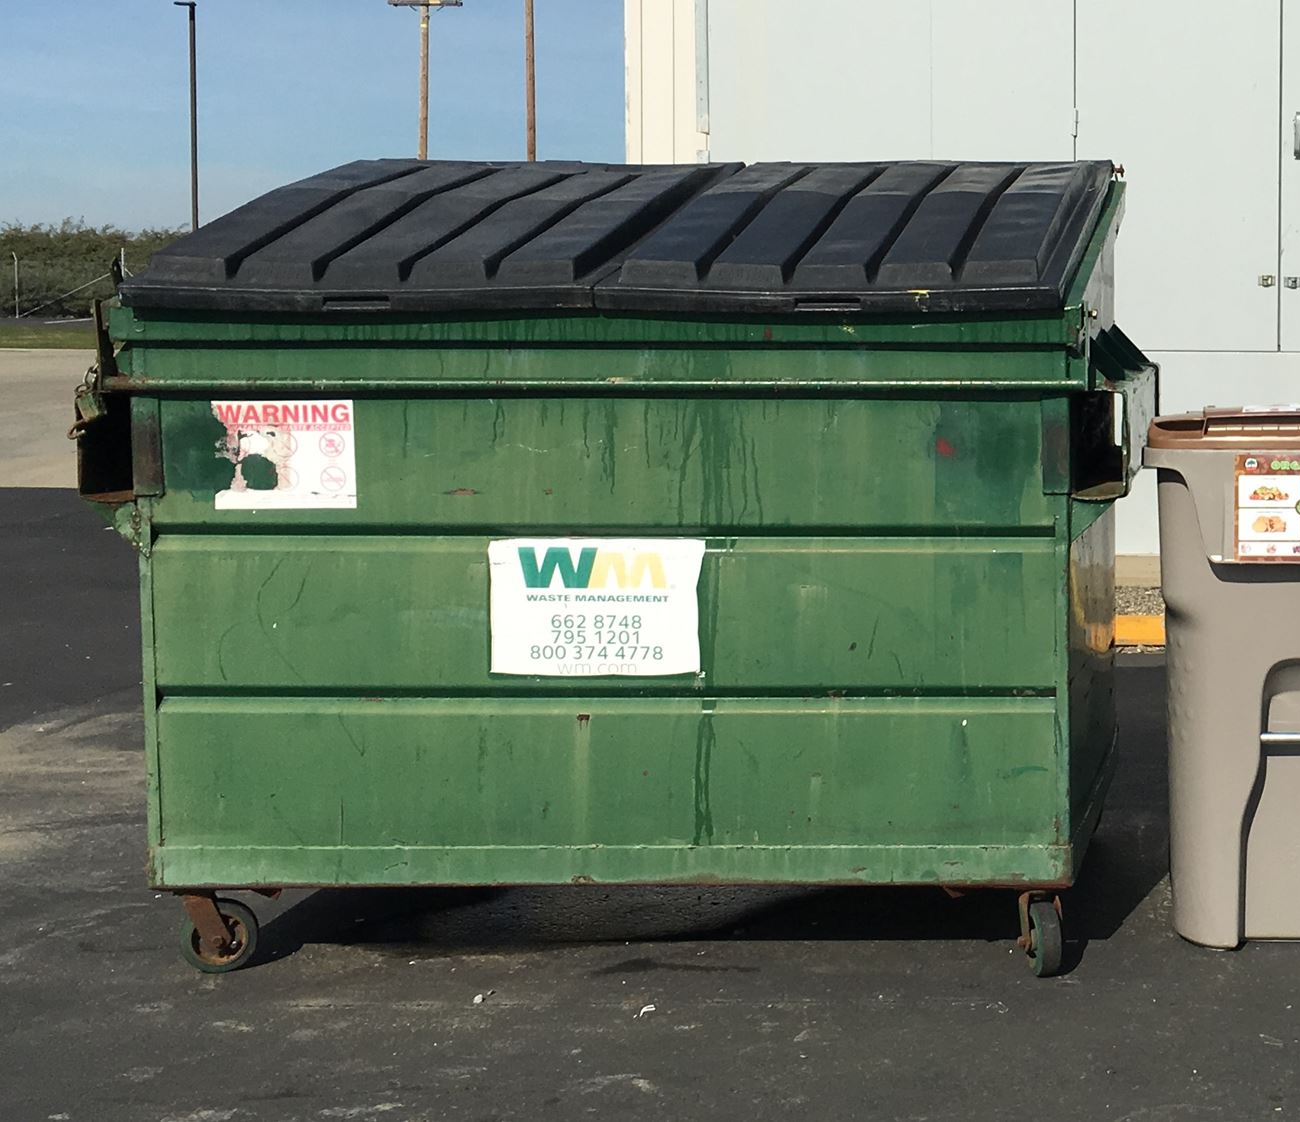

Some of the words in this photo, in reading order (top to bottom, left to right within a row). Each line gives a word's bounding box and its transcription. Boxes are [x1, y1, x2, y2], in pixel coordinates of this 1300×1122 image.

[216, 404, 350, 423] WARNING
[518, 547, 667, 588] WM
[526, 594, 571, 602] WASTE
[551, 614, 586, 629] 662
[593, 614, 642, 629] 8748
[551, 630, 586, 644] 795
[594, 630, 640, 644] 1201
[530, 645, 566, 660] 800
[573, 645, 608, 660] 374
[615, 646, 663, 660] 4778
